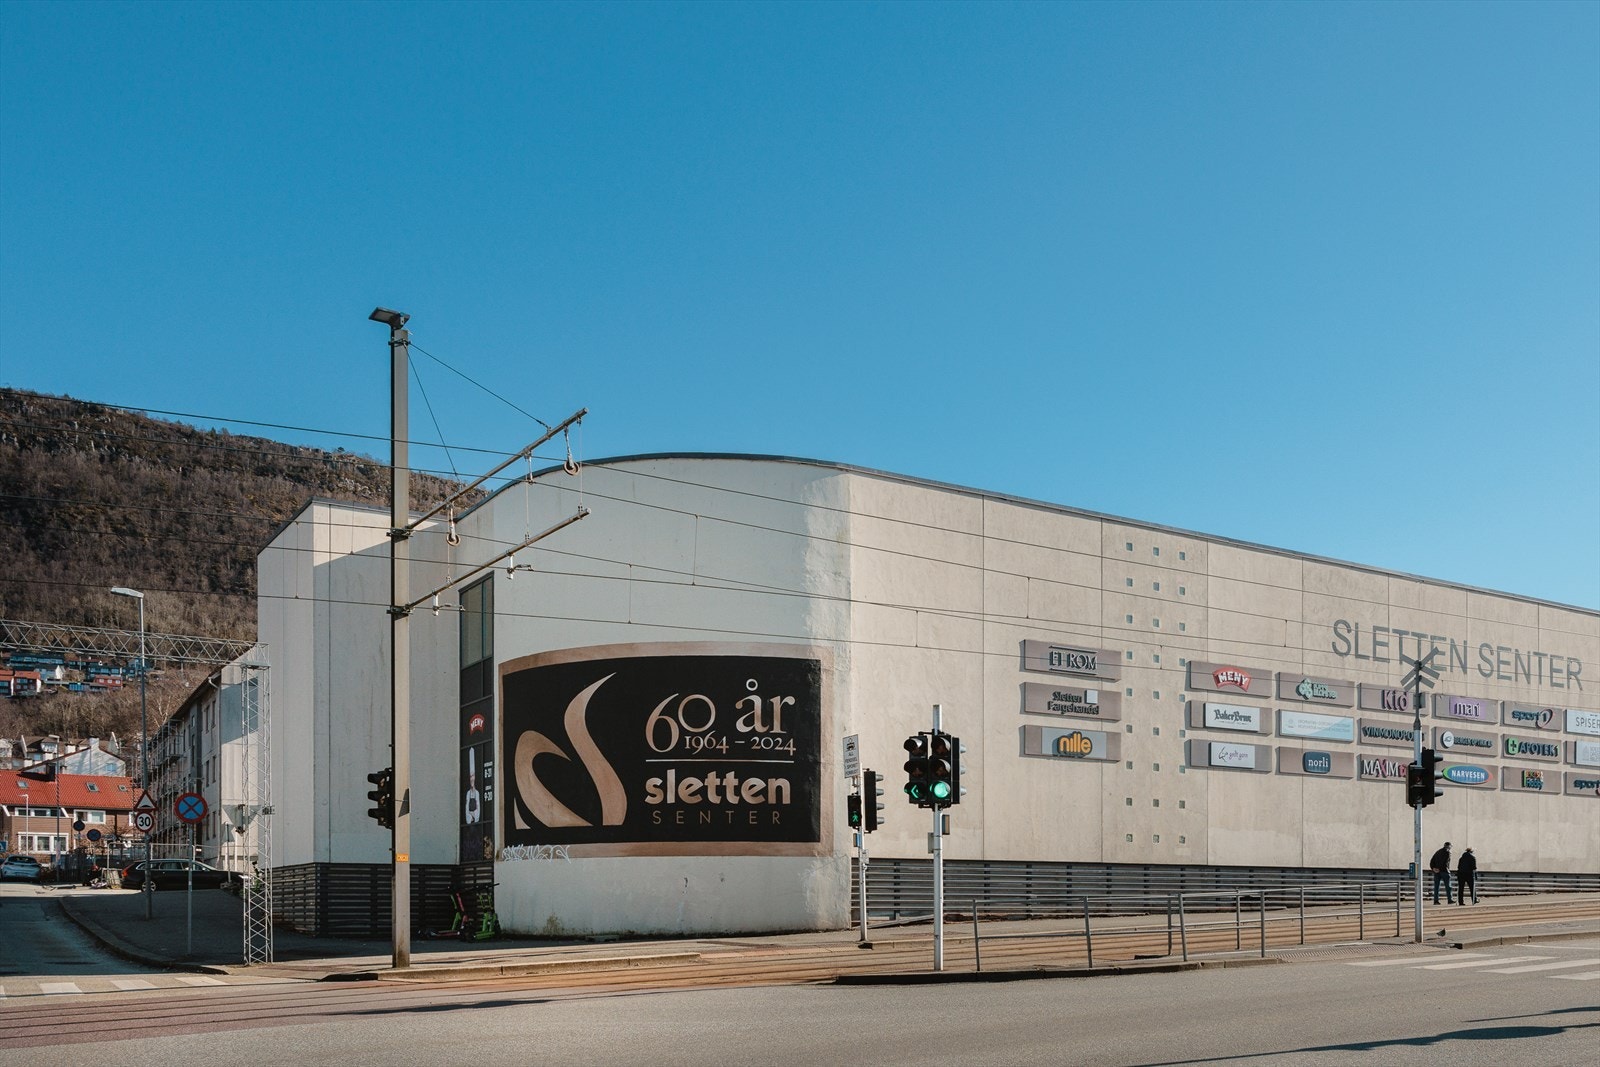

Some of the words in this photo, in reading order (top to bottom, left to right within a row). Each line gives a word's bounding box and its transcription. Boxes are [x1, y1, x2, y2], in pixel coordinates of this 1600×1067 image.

[1049, 650, 1063, 667] ET
[1067, 653, 1098, 671] ROM
[1332, 619, 1468, 675] SLETTEN
[1477, 643, 1583, 691] SENTER
[1217, 671, 1250, 686] MENY
[1381, 689, 1409, 711] Kid
[470, 717, 484, 731] MENY
[645, 693, 716, 753] 60
[735, 678, 796, 734] år
[684, 730, 729, 755] 1964
[751, 736, 797, 756] 2024
[1058, 732, 1092, 755] nille
[1307, 756, 1329, 768] norli
[1451, 769, 1486, 780] NARVESEN
[644, 768, 792, 805] sletten
[138, 816, 151, 827] 30
[652, 810, 781, 825] SENTER
